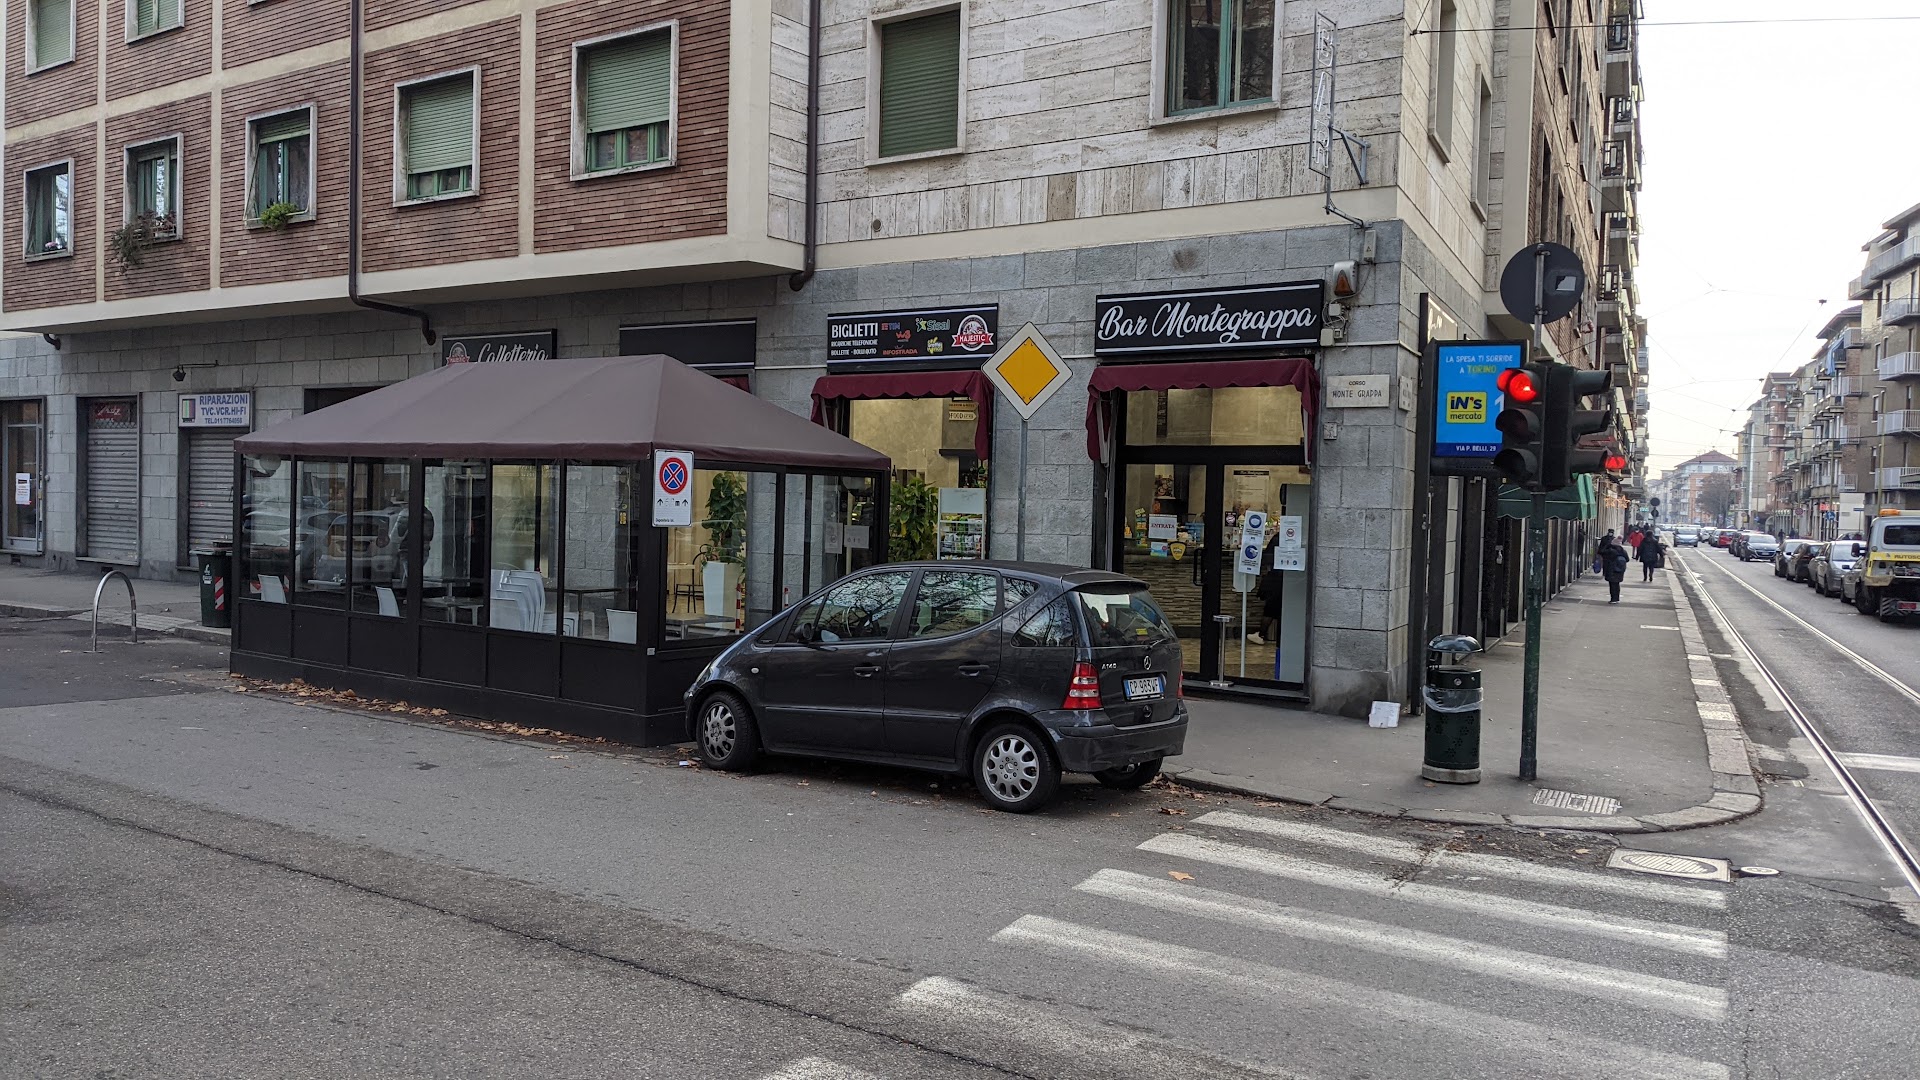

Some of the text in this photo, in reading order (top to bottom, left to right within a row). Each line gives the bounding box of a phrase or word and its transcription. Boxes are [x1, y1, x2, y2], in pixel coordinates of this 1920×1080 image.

[1098, 301, 1317, 344] Bar Montegrappa
[831, 322, 879, 338] BIGLIETTI
[959, 334, 986, 342] MAJESTIC
[1486, 354, 1513, 362] SORRIDE
[1459, 365, 1497, 374] A TORINO
[1332, 389, 1382, 398] MONTE GRAPPA
[199, 394, 248, 405] RIPARAZIONI
[1450, 412, 1482, 420] mercato
